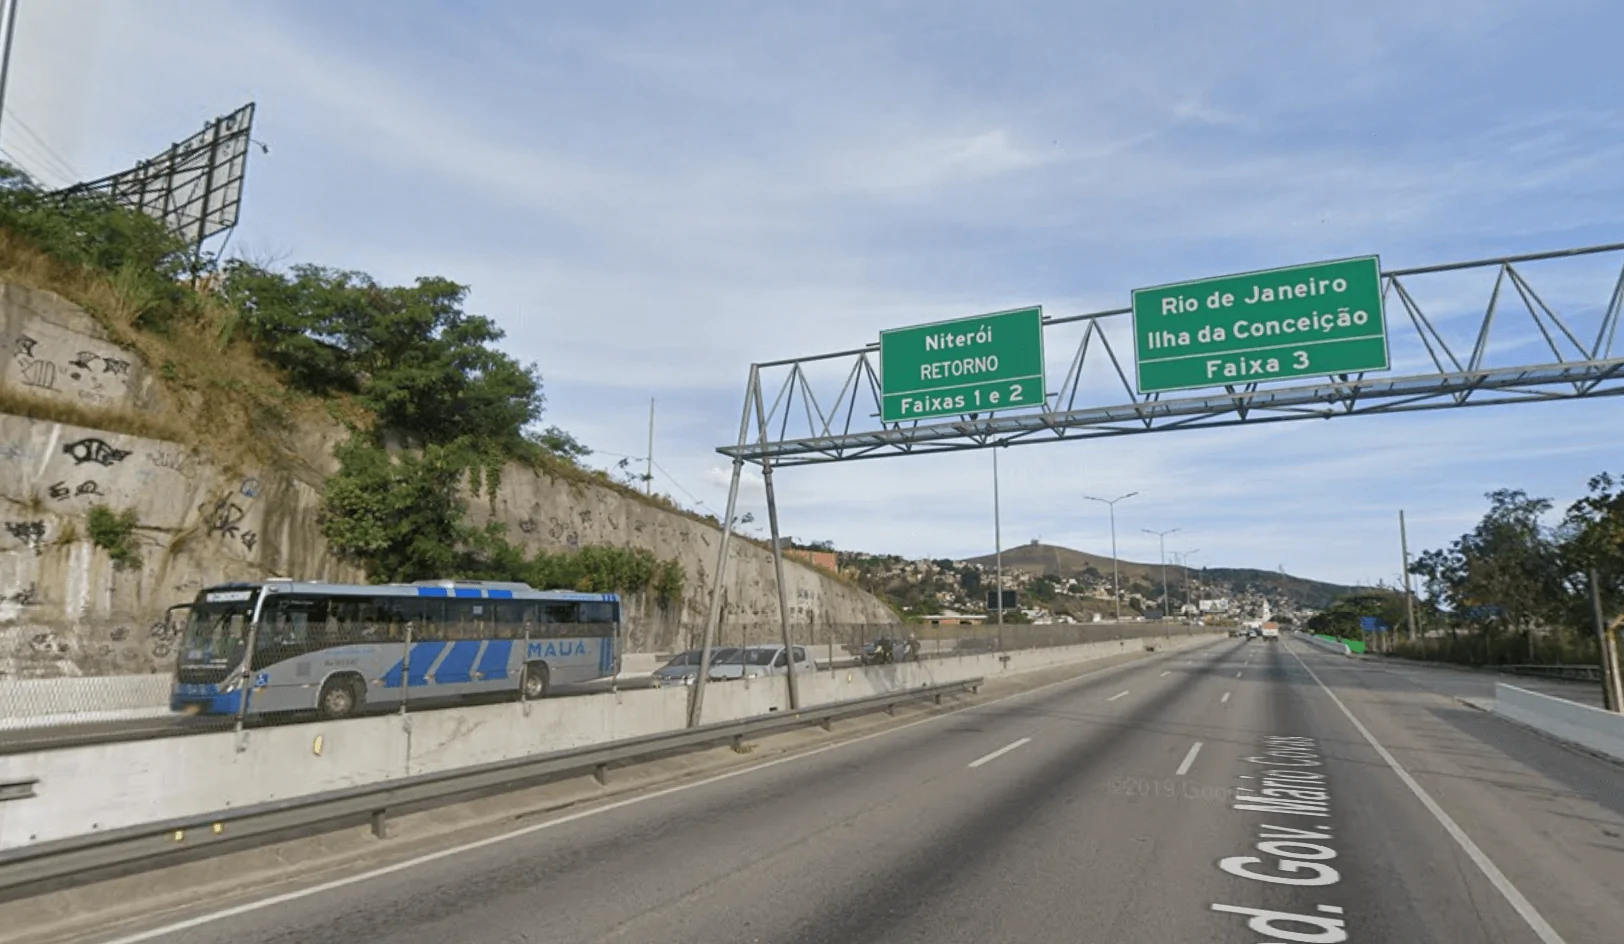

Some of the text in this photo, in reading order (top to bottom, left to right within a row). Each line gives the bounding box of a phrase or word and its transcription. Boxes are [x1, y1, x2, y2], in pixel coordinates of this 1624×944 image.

[1161, 278, 1348, 315] Rio de Janeiro
[925, 324, 993, 351] Niterói
[1148, 307, 1369, 349] Ilha da Conceição
[920, 355, 999, 380] RETORNO
[1206, 351, 1310, 378] Faixa 3
[901, 384, 1023, 414] Faixas 1 e 2
